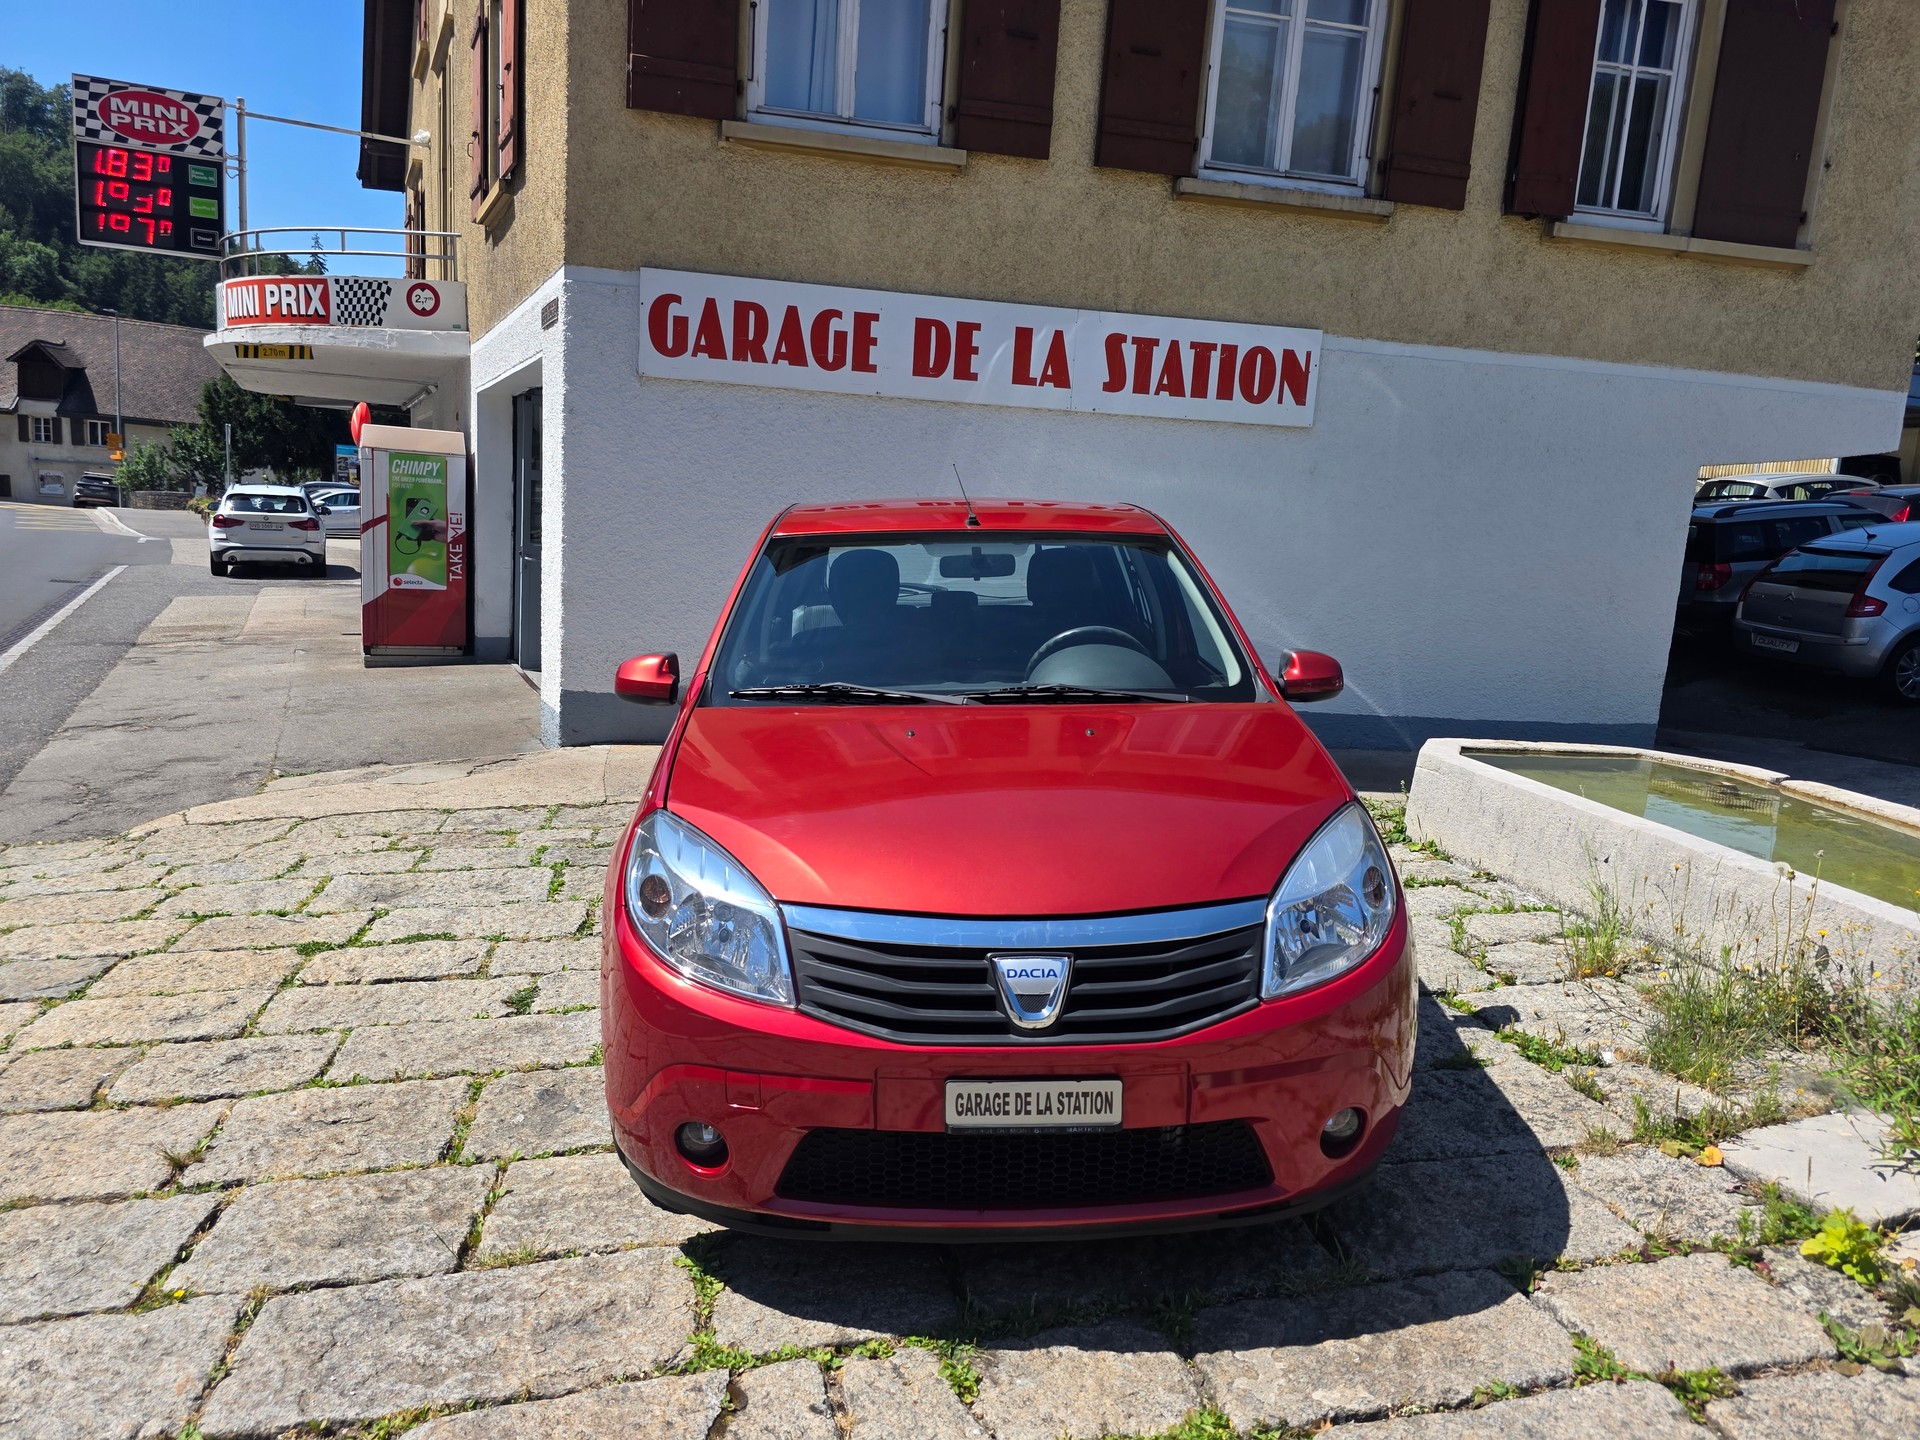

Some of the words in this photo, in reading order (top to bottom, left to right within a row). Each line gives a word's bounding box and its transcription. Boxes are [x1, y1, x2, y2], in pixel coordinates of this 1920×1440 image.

[110, 97, 190, 123] MINI
[110, 113, 190, 138] PRIX
[227, 284, 260, 320] MINI
[265, 283, 326, 317] PRIX
[647, 292, 881, 375] GARAGE
[912, 316, 982, 382] DE
[1010, 326, 1072, 389] LA
[1102, 332, 1312, 407] STATION
[392, 459, 441, 476] CHIMPY
[450, 512, 463, 540] ME!
[450, 543, 463, 582] TAKE
[1758, 637, 1792, 649] QUALITY
[1006, 968, 1057, 979] DACIA
[955, 1092, 1011, 1117] GARAGE
[1014, 1092, 1031, 1116] DE
[1036, 1092, 1053, 1115] LA
[1057, 1090, 1114, 1115] STATION
